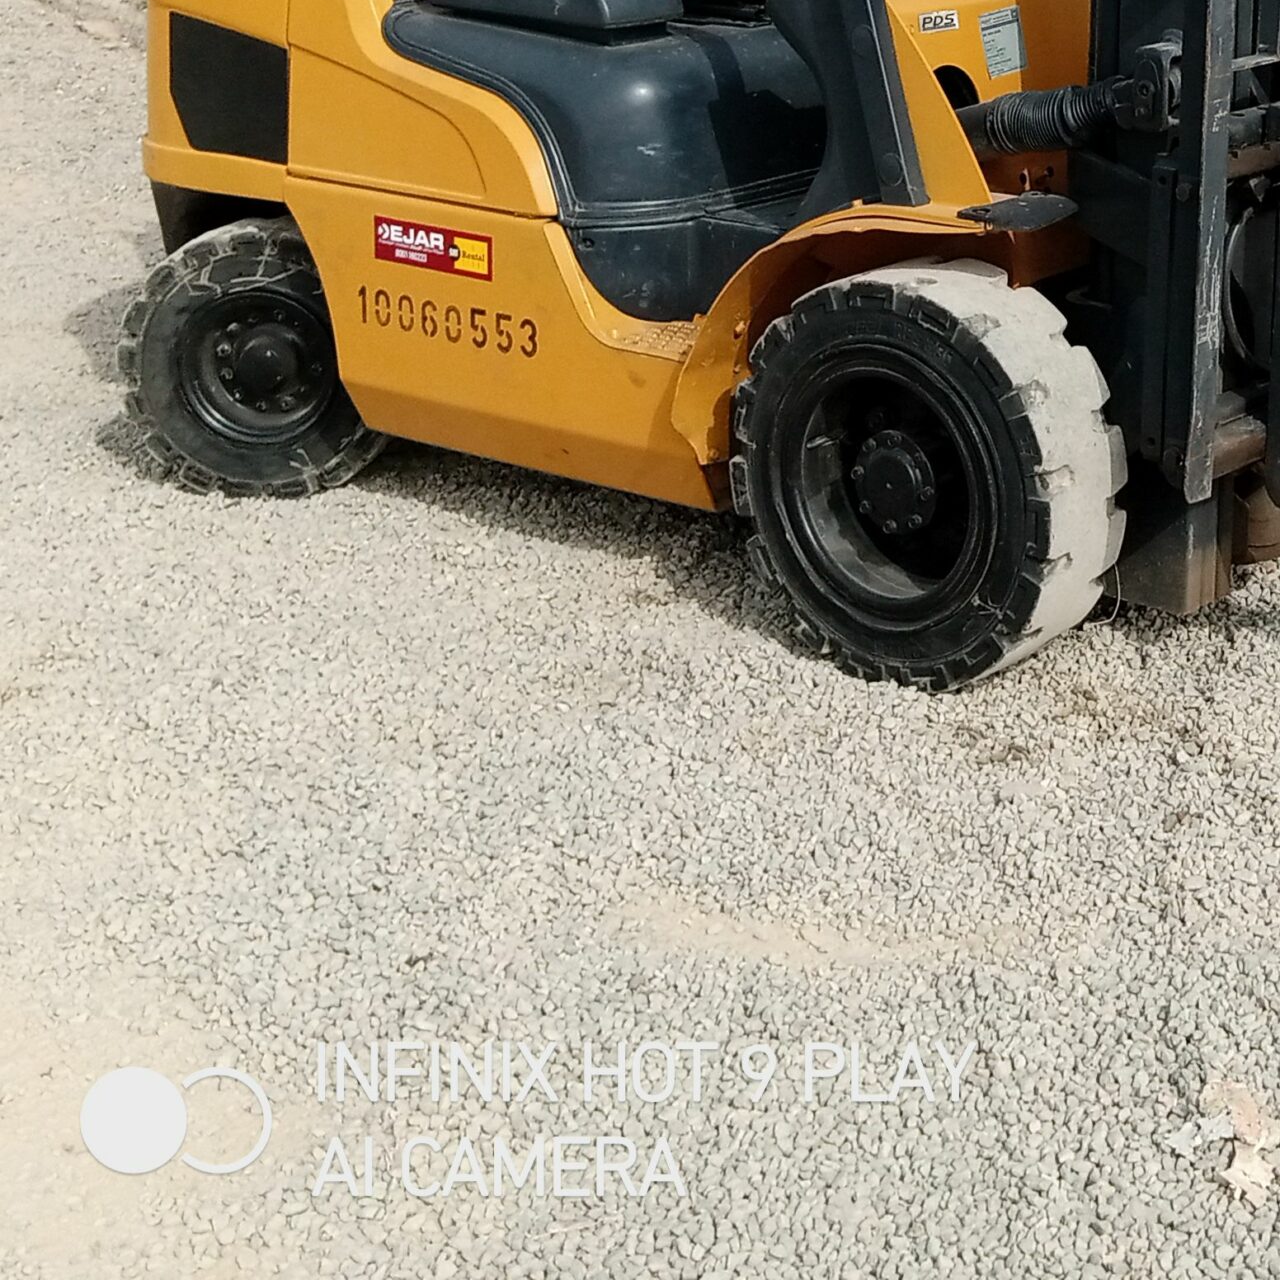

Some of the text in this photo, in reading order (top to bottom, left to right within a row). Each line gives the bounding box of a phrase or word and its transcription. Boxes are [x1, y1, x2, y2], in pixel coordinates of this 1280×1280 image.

[922, 13, 955, 29] PDS
[462, 250, 485, 262] Rental
[358, 285, 538, 358] 10060553
